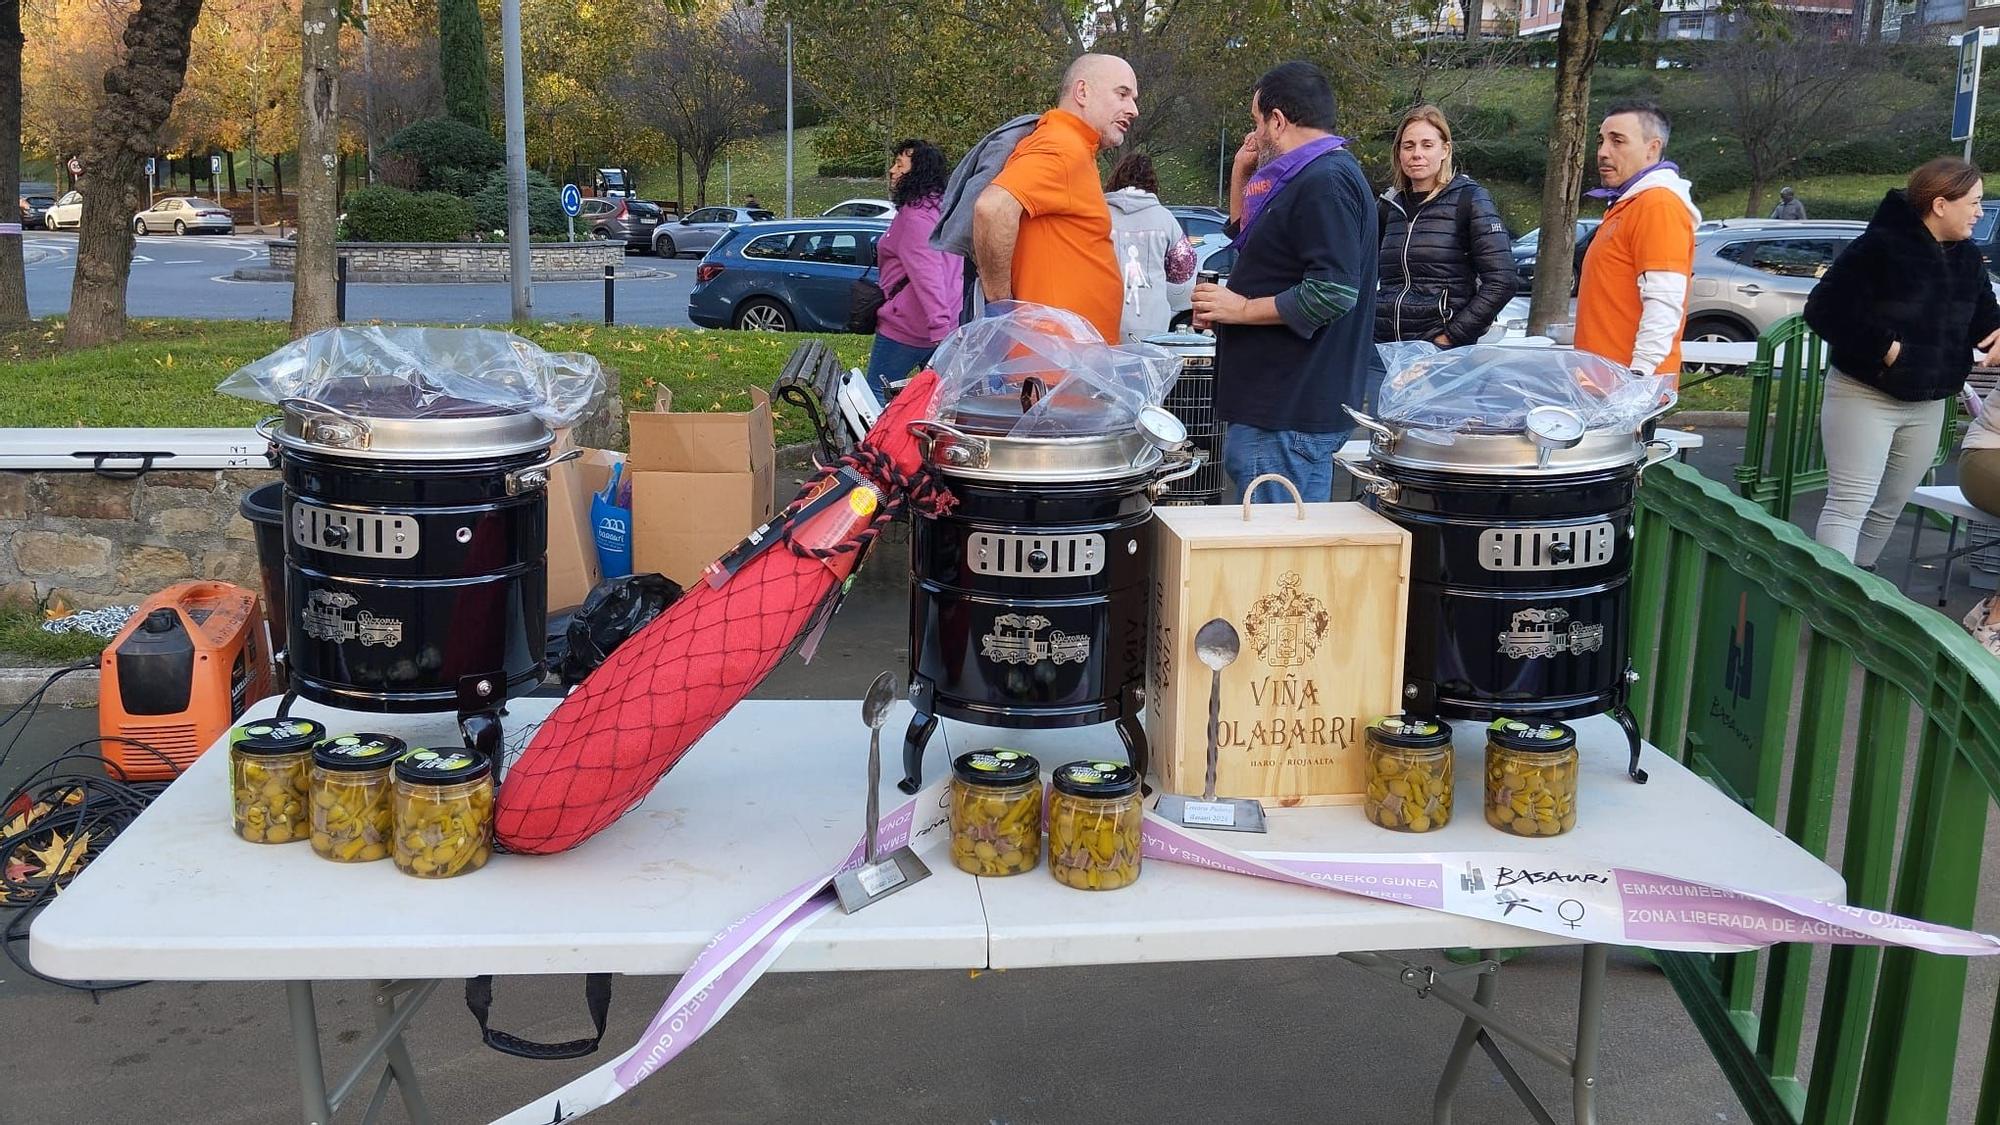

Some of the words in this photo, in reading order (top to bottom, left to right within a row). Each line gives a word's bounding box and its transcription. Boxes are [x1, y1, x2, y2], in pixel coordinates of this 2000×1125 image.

[1250, 673, 1320, 710] VIÑA
[1215, 716, 1358, 751] OLABARRI
[1250, 759, 1276, 767] HARO
[1310, 871, 1377, 884] GABEKO
[1382, 877, 1439, 889] GUNEA
[1628, 909, 1677, 923] ZONA
[1681, 910, 1768, 931] LIBERADA
[1772, 918, 1796, 933] DE
